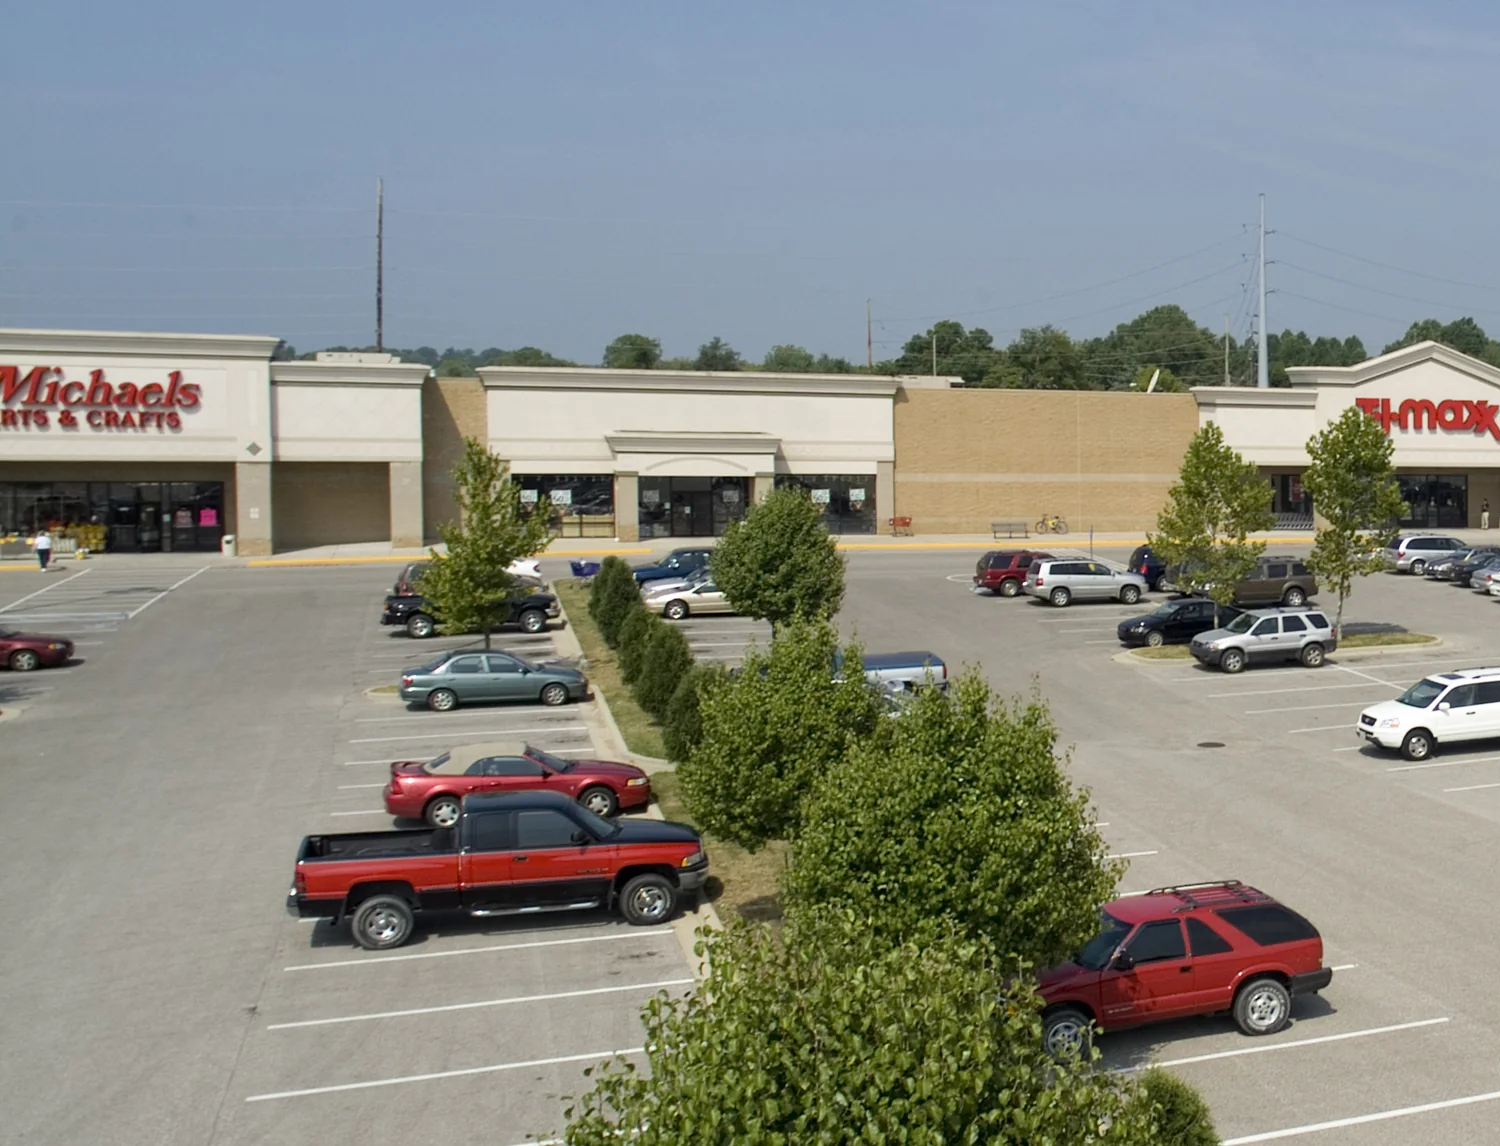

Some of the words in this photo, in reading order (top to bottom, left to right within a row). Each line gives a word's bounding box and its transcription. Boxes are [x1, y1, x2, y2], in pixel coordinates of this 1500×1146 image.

[0, 366, 201, 408] Michaels
[0, 409, 49, 426] RTS
[58, 409, 78, 428] &
[86, 410, 182, 429] CRAFTS
